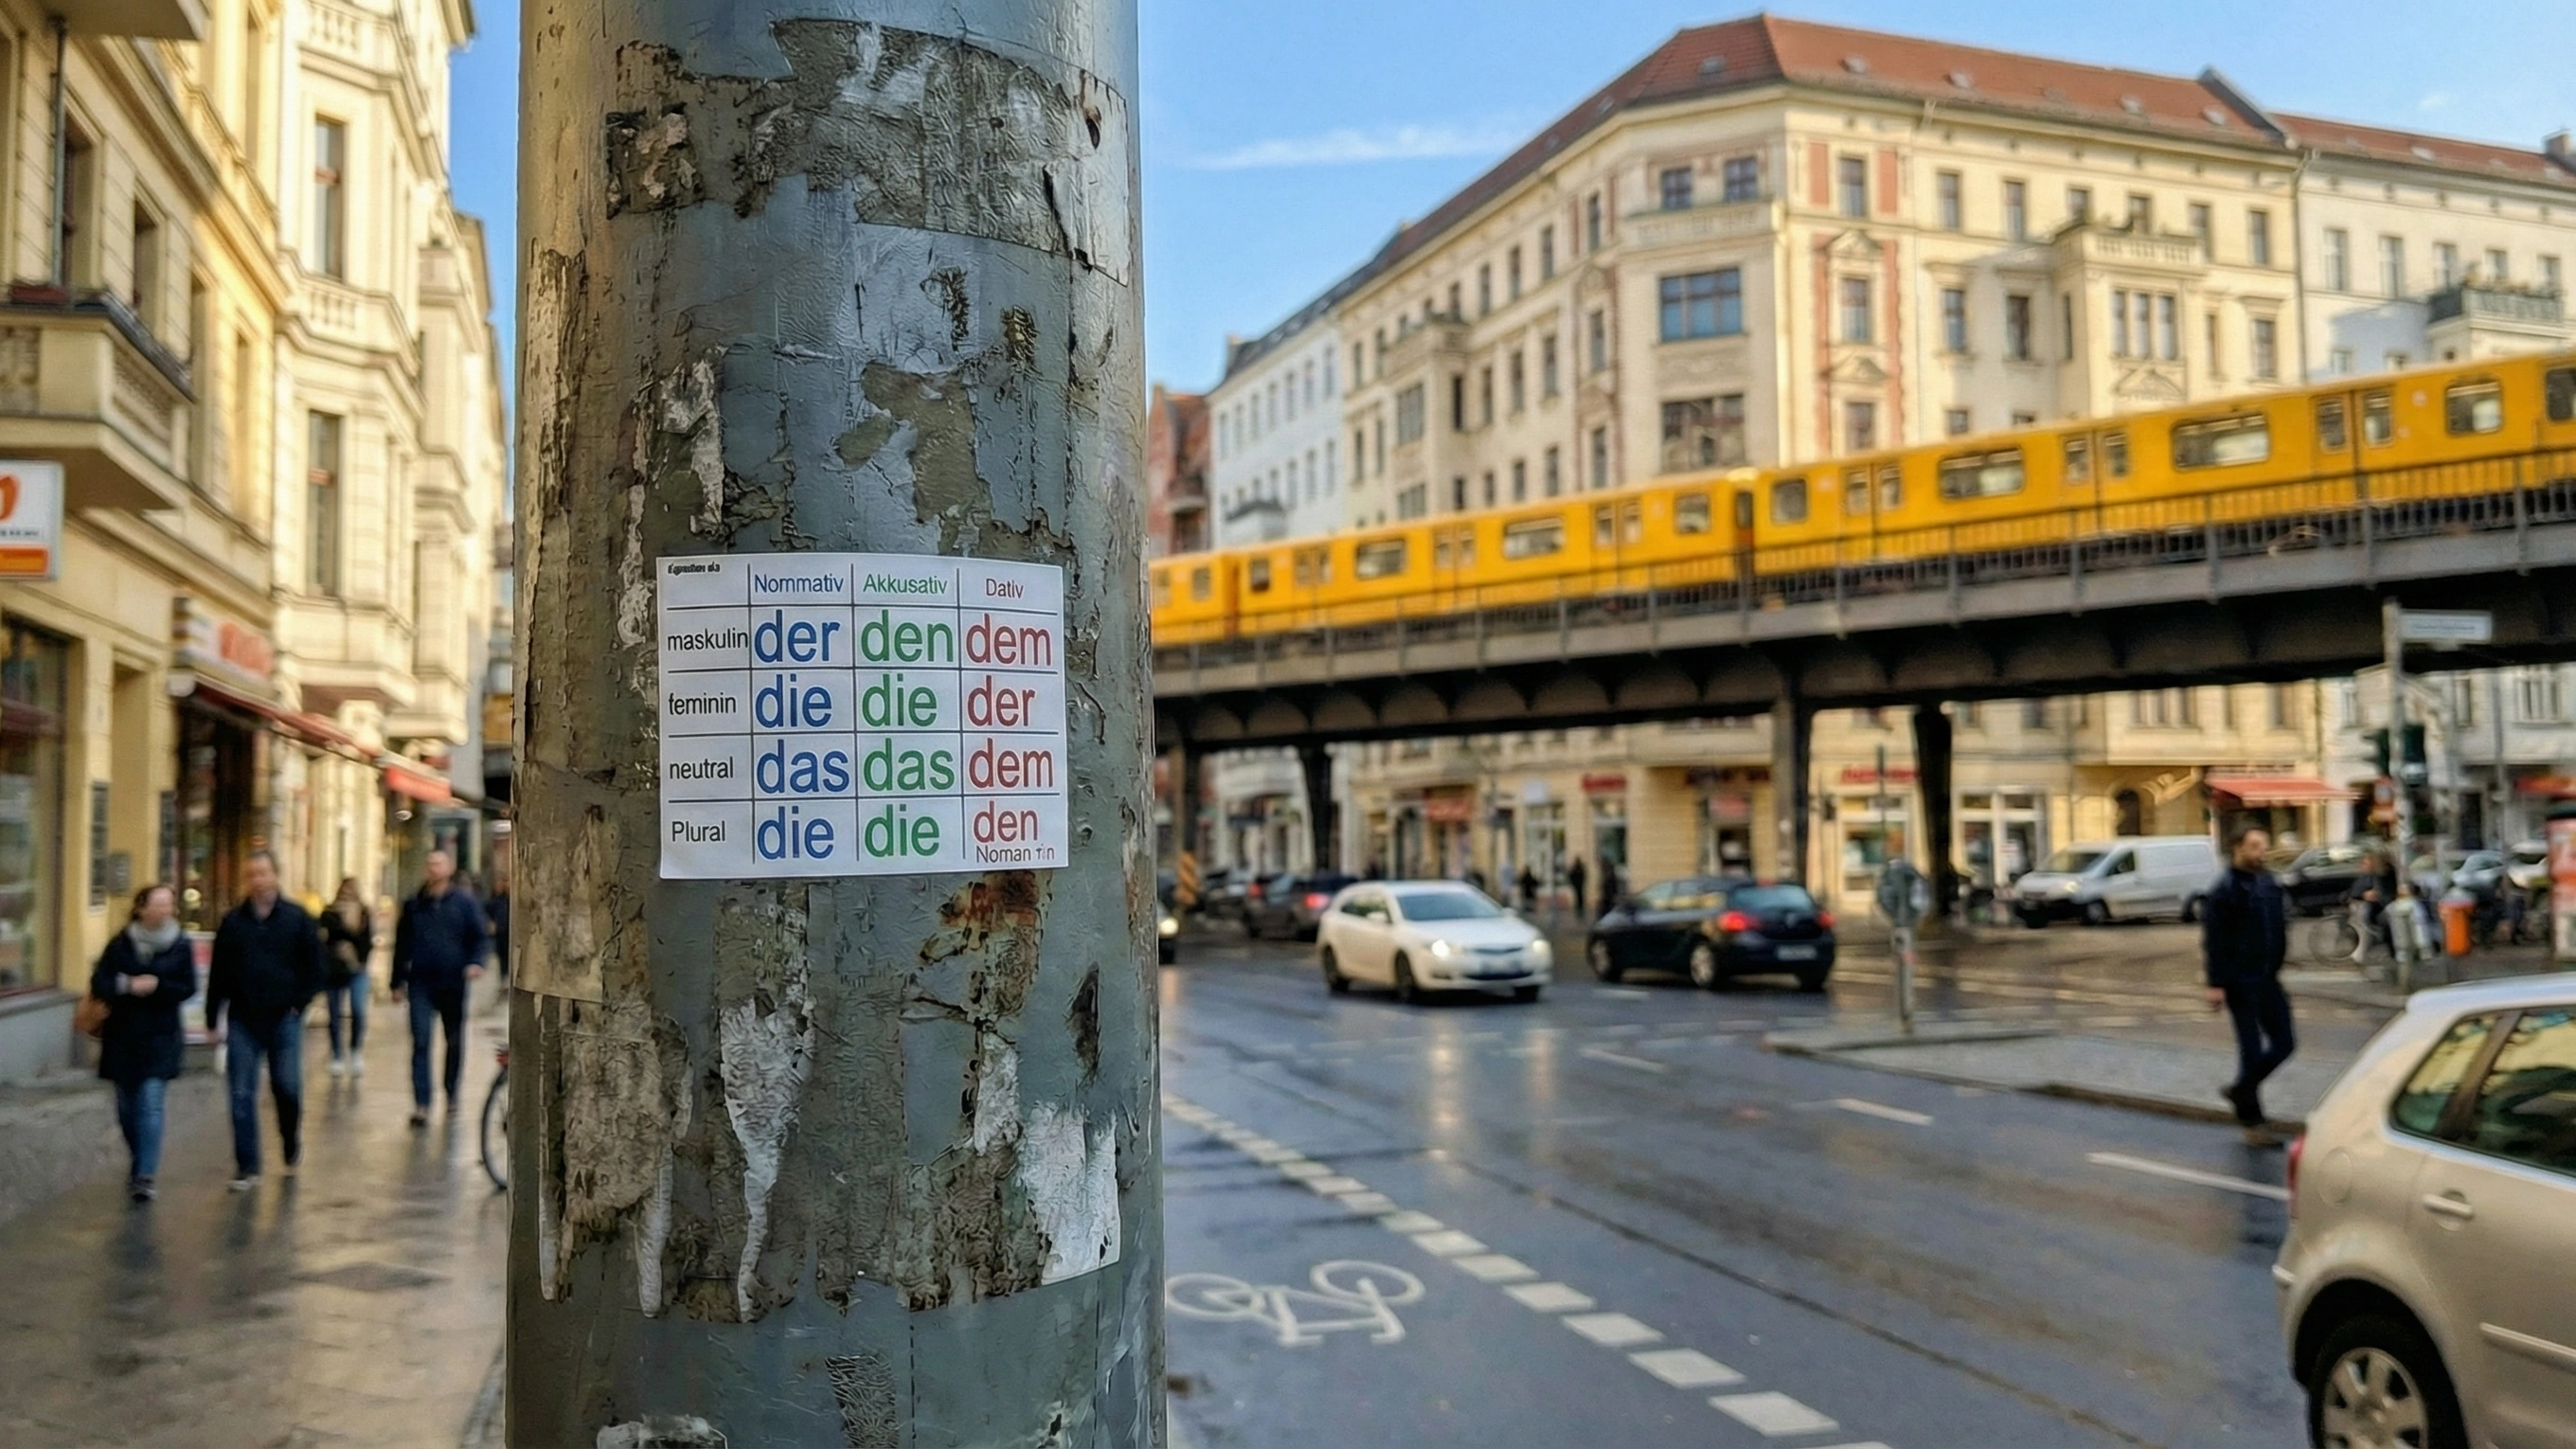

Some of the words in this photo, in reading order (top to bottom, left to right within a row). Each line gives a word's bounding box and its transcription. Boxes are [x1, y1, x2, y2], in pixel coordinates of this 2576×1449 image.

[863, 574, 947, 594] Akkusativ
[986, 579, 1023, 599] Dativ
[668, 627, 748, 651] maskulin
[754, 609, 840, 663] der
[861, 609, 954, 662] den
[966, 613, 1051, 666] dem
[669, 692, 736, 715] feminin
[756, 673, 832, 727] die
[862, 673, 937, 726] die
[968, 675, 1035, 726] der
[670, 756, 733, 779] neutral
[758, 739, 850, 794] das
[864, 738, 955, 791] das
[969, 738, 1053, 788] dem
[672, 820, 725, 842] Plural
[758, 806, 833, 860] die
[865, 804, 939, 857] die
[974, 800, 1037, 843] den
